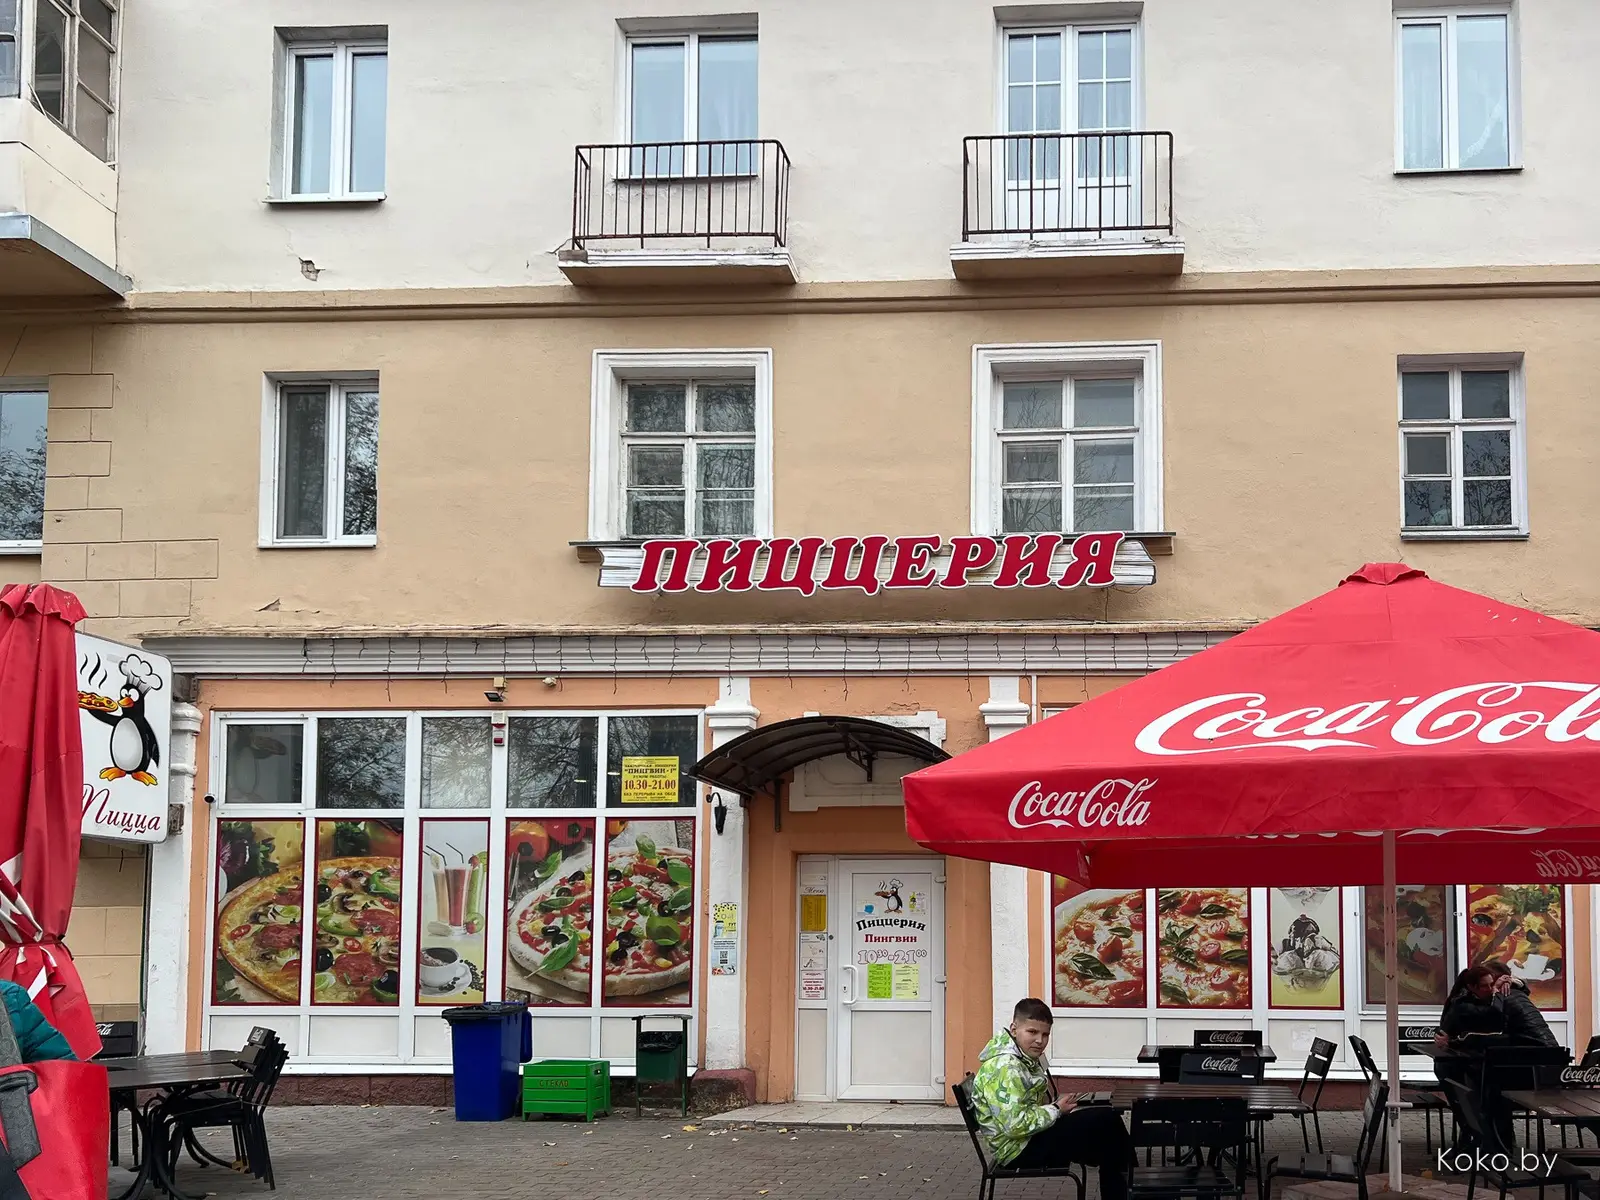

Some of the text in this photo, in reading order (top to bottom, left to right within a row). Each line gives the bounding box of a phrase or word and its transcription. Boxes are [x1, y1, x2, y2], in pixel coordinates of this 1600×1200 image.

[630, 532, 1126, 596] ПИЦЦЕРИЯ
[1134, 681, 1600, 755] Coca-Col
[624, 779, 676, 790] 10.30-21.00
[82, 783, 161, 835] Пицца
[1007, 778, 1159, 830] Coca-Cola
[855, 918, 926, 931] Пиццерия
[864, 934, 917, 943] Пингвин
[1209, 1031, 1245, 1043] Coca-Cola
[1201, 1056, 1241, 1072] Coca-Cola
[539, 1079, 569, 1088] СТЕКЛО
